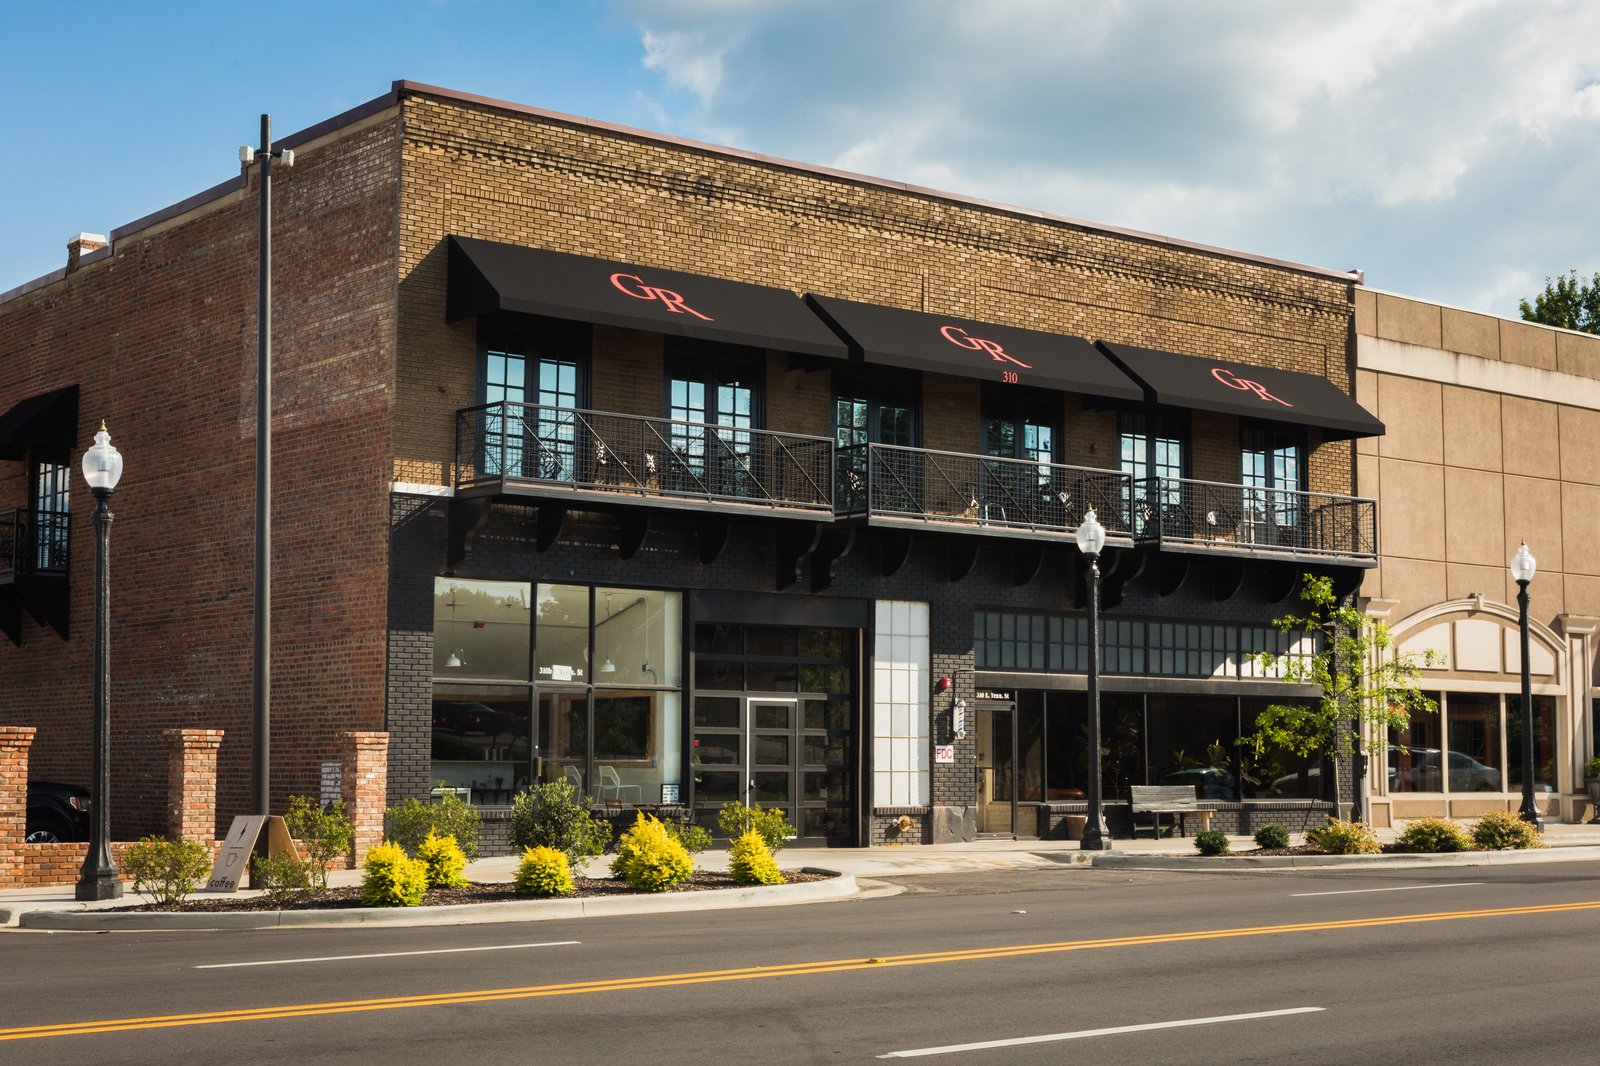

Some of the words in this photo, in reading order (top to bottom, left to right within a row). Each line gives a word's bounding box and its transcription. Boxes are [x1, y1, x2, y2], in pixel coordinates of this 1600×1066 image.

[610, 273, 715, 321] GR
[940, 326, 1032, 369] GR
[1003, 372, 1017, 384] 310
[1211, 368, 1293, 407] GR
[936, 748, 952, 759] FDC
[210, 876, 235, 888] coffee
